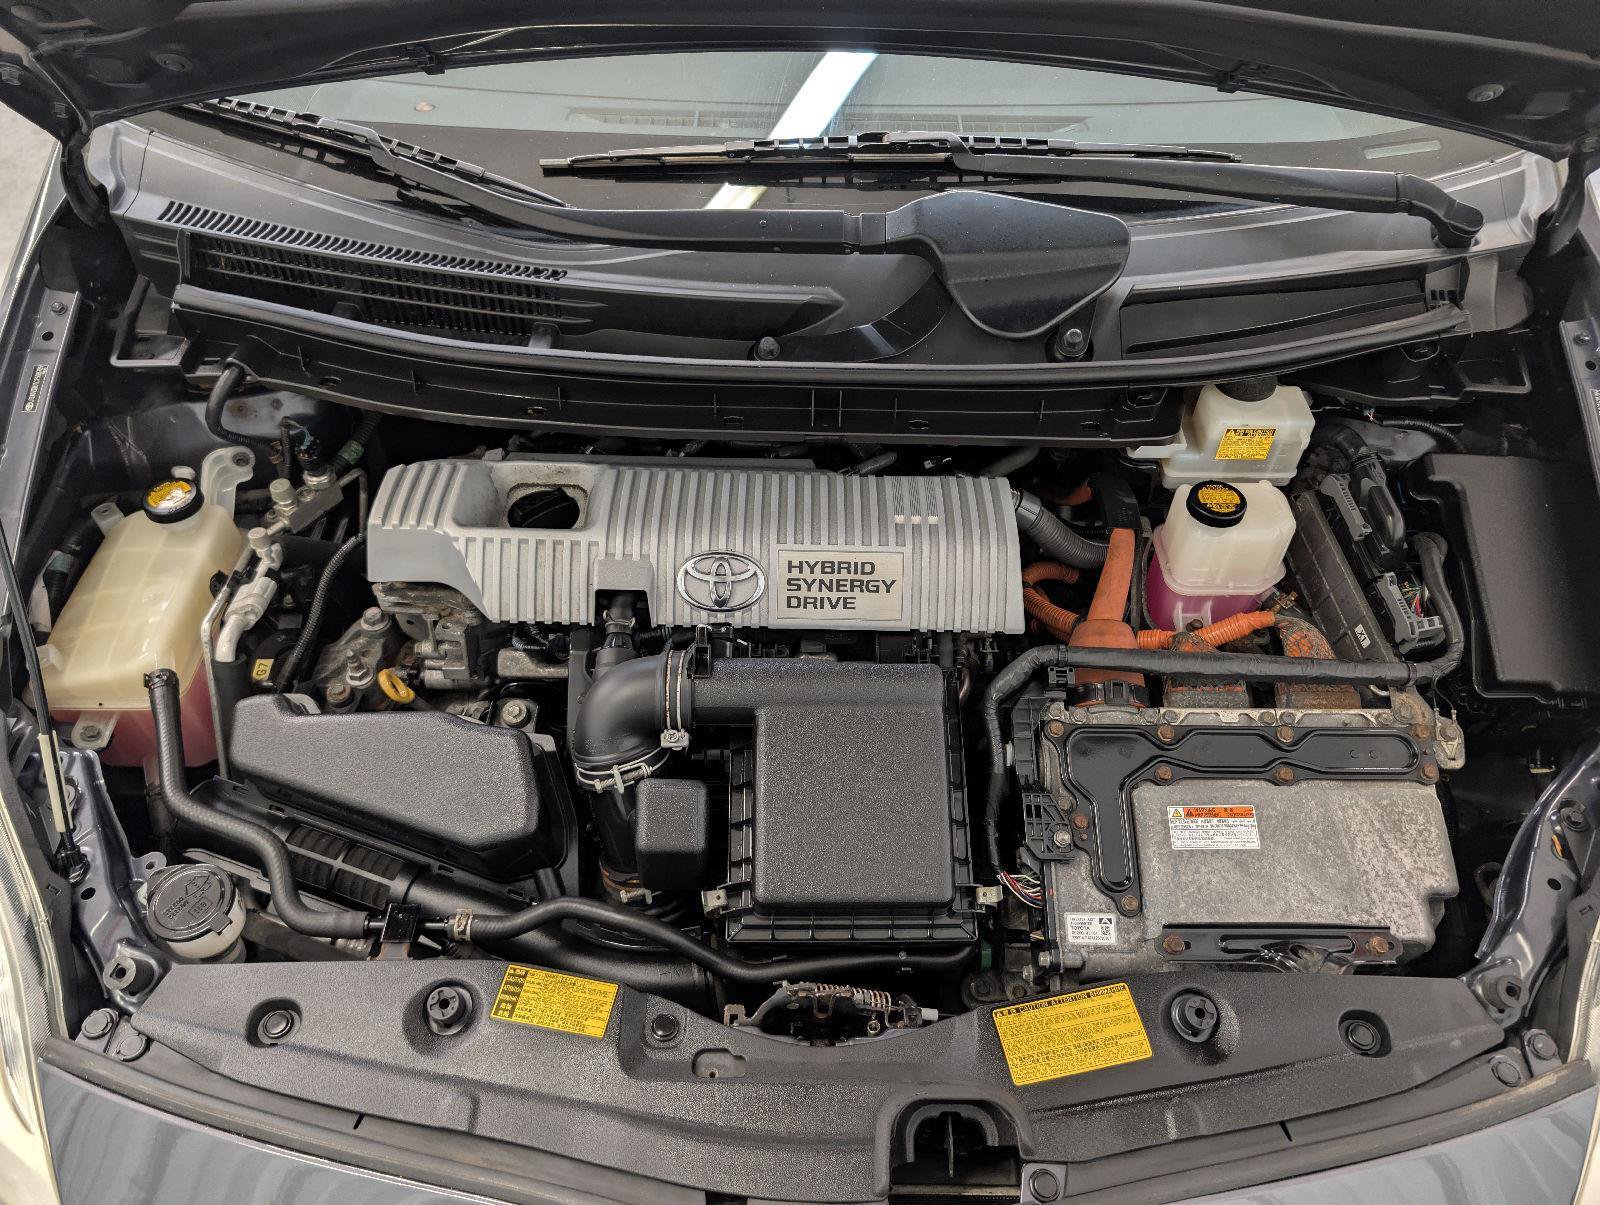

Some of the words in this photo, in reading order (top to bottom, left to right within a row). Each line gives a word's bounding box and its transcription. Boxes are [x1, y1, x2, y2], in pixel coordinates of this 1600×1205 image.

[787, 560, 876, 575] HYBRID
[786, 578, 897, 594] SYNERGY
[786, 596, 857, 610] DRIVE
[1019, 1002, 1049, 1013] CAUTION
